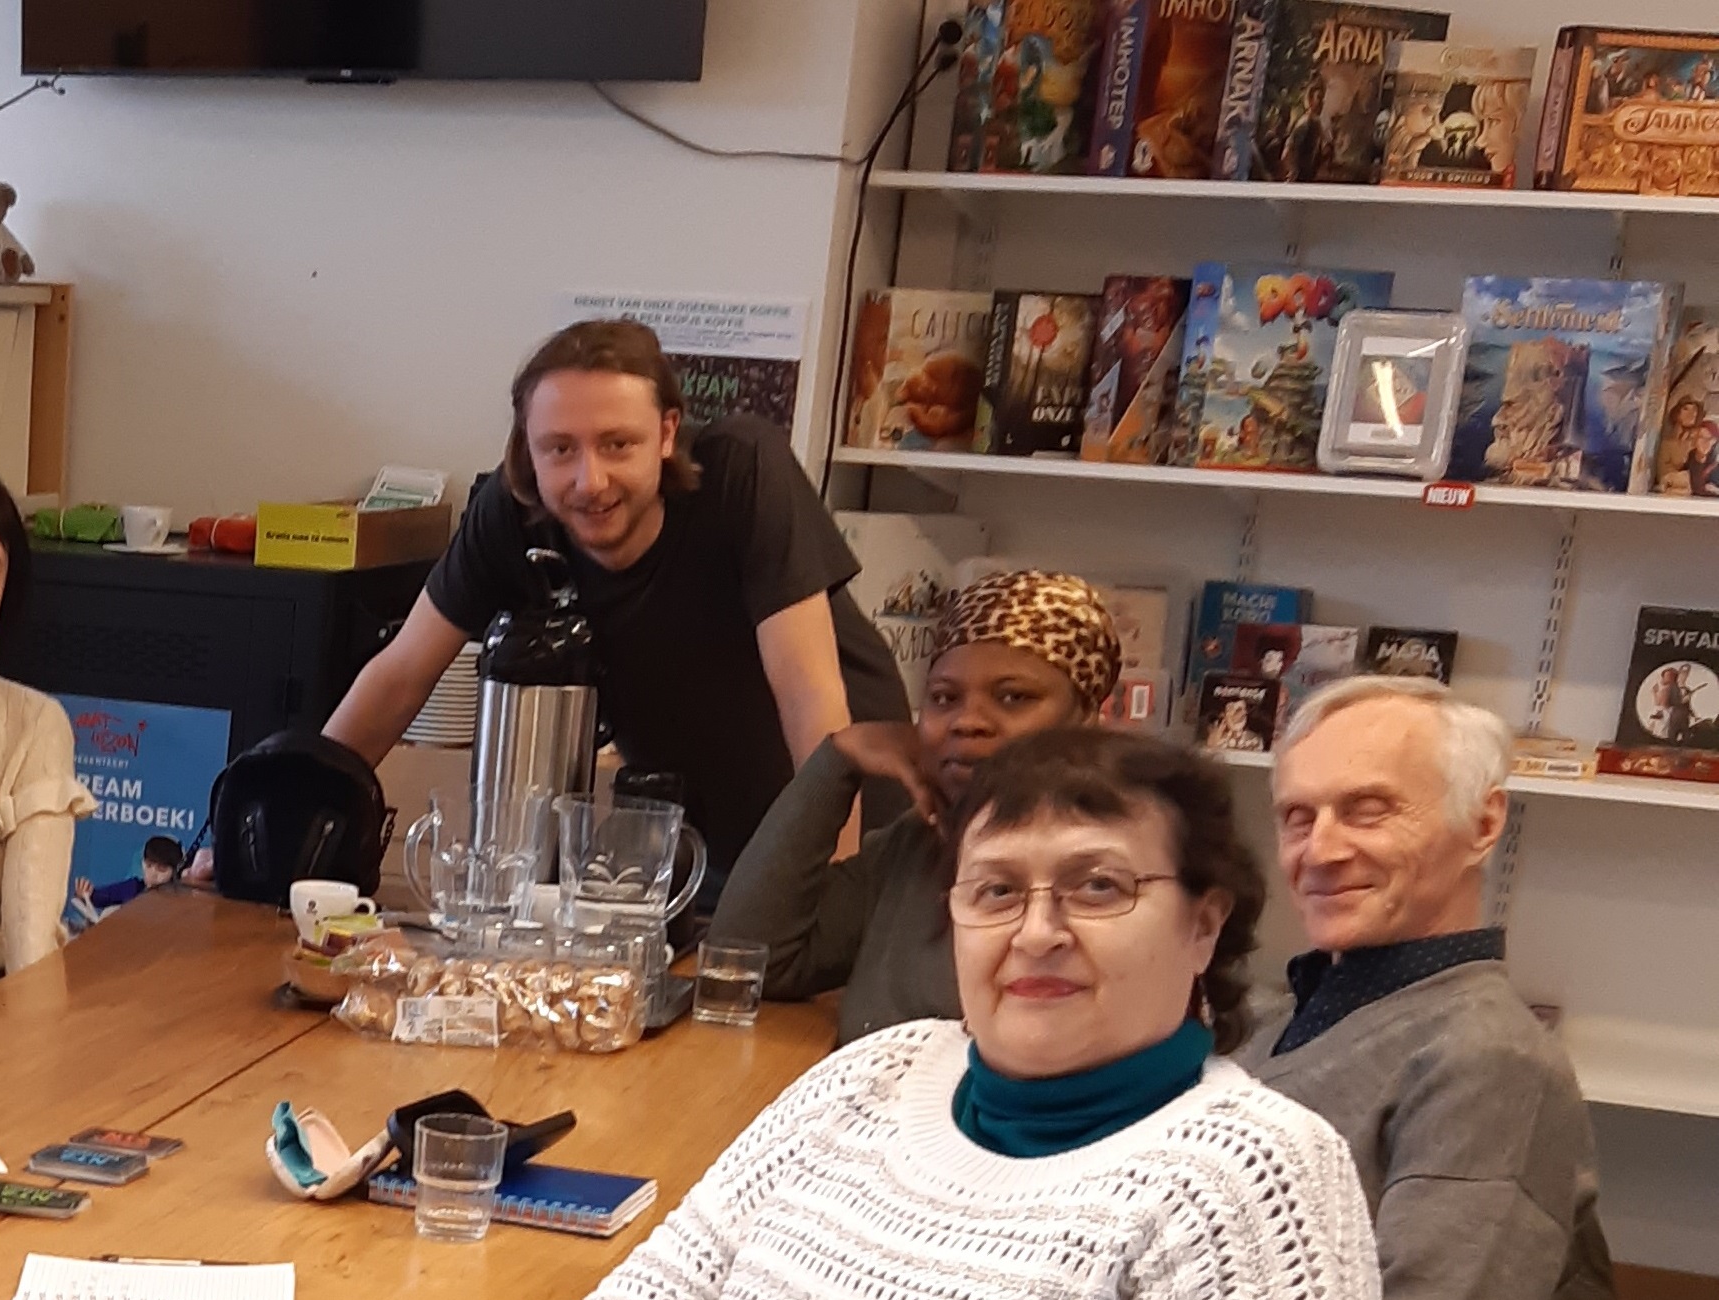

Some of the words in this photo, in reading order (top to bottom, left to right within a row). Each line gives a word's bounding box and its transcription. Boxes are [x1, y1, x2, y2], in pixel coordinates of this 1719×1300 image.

[1312, 19, 1399, 66] ARNA
[1108, 16, 1139, 131] IMHOTEP
[682, 368, 740, 400] XFAM
[1426, 485, 1473, 507] NIEUW
[1375, 640, 1441, 663] MAFIA
[1643, 628, 1719, 650] SPYFAL
